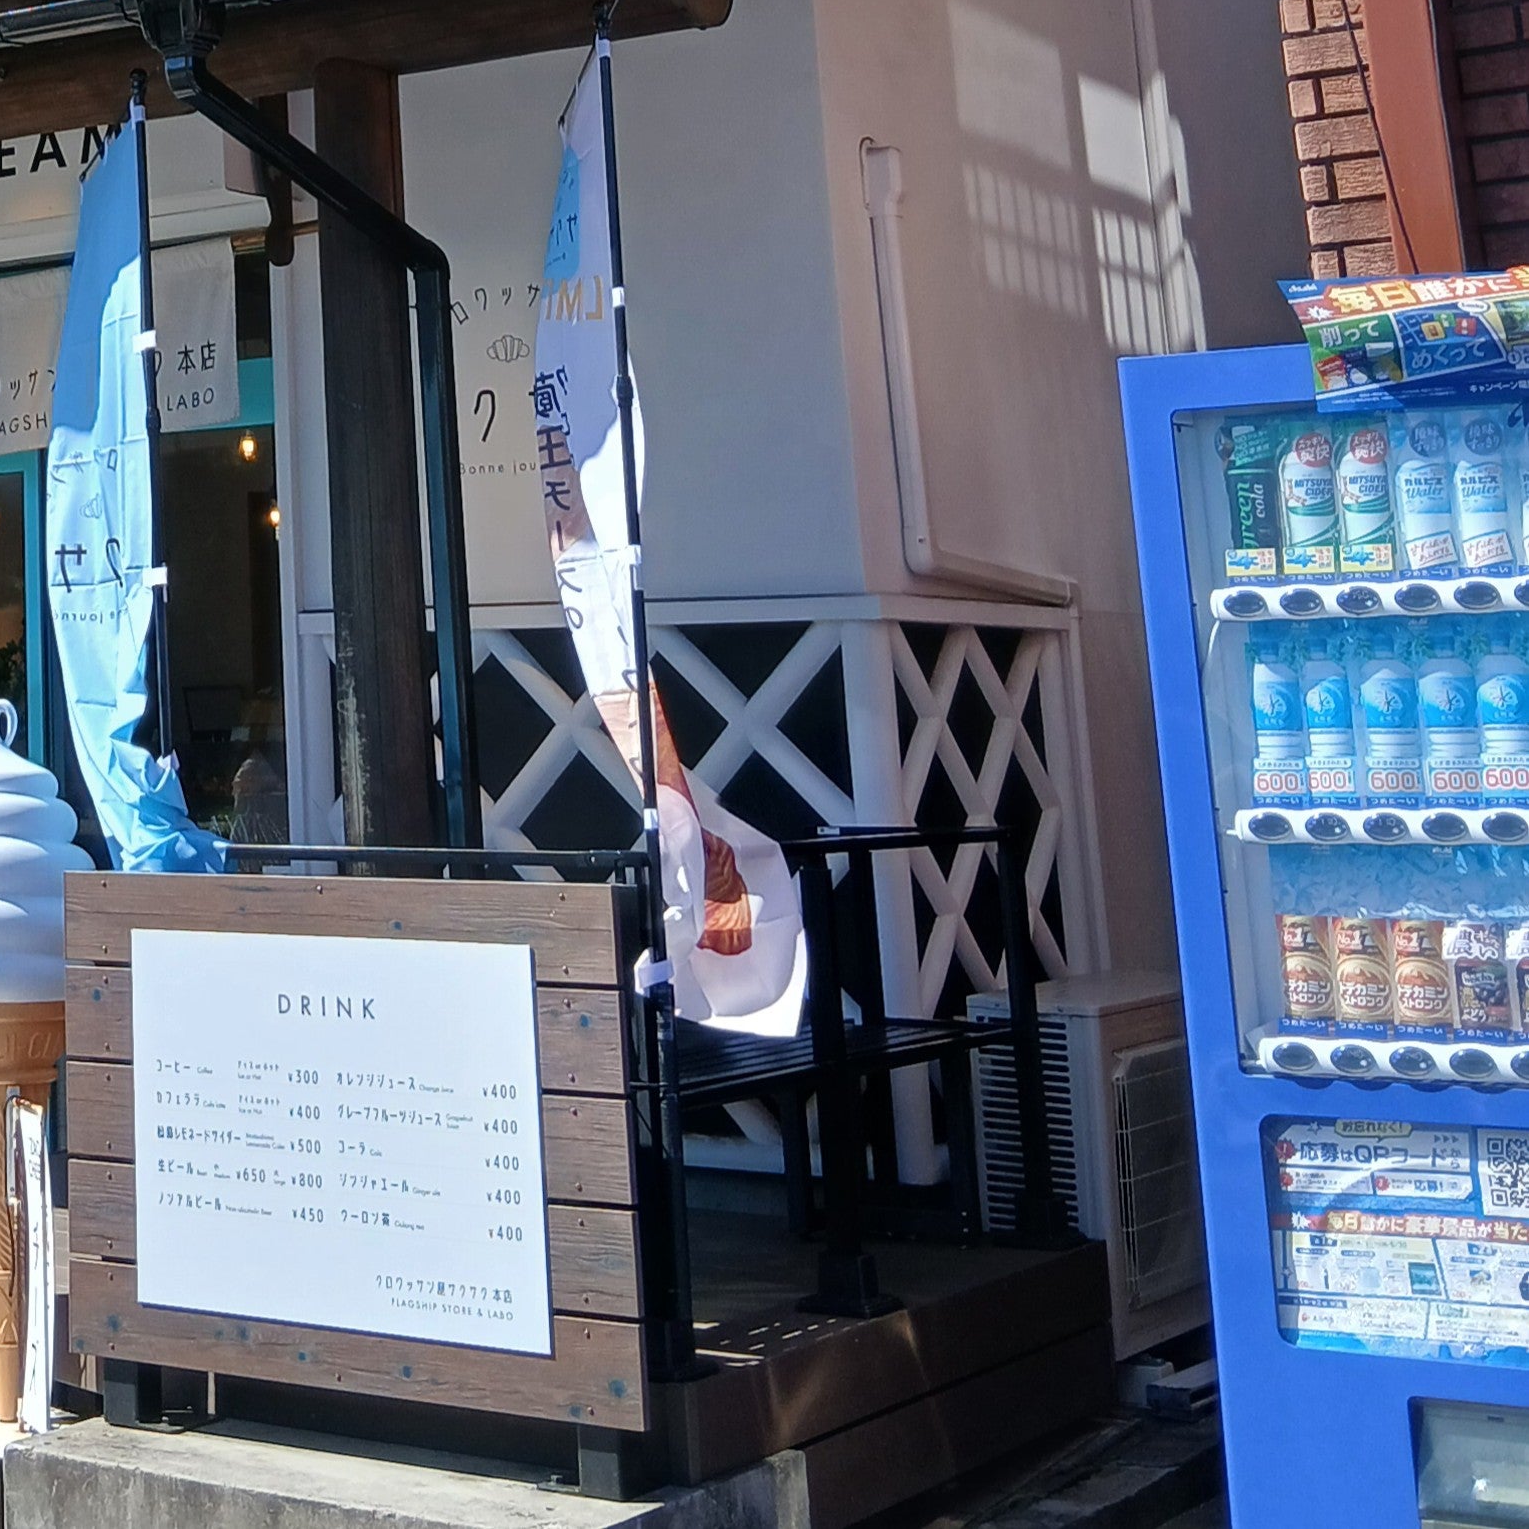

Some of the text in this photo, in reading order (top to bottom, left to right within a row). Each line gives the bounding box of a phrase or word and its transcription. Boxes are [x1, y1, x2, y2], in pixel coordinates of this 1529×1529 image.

[1318, 320, 1379, 348] 削って
[177, 339, 217, 375] 本店
[1412, 338, 1486, 369] めくって
[166, 387, 215, 411] LABO
[1253, 483, 1266, 518] cola
[277, 993, 377, 1020] DRINK
[156, 1059, 191, 1073] コーヒー
[287, 1069, 319, 1085] ¥300
[482, 1084, 517, 1100] ¥400
[289, 1105, 321, 1120] ¥400
[483, 1118, 518, 1135] ¥400
[290, 1138, 321, 1154] ¥500
[338, 1139, 366, 1155] コーラ
[484, 1154, 520, 1171] ¥400
[236, 1167, 267, 1183] ¥650
[291, 1172, 323, 1189] ¥800
[486, 1188, 521, 1205] ¥400
[292, 1207, 324, 1223] ¥450
[488, 1225, 523, 1242] ¥400
[391, 1297, 438, 1311] FLAGSHIP
[441, 1303, 472, 1316] STORE
